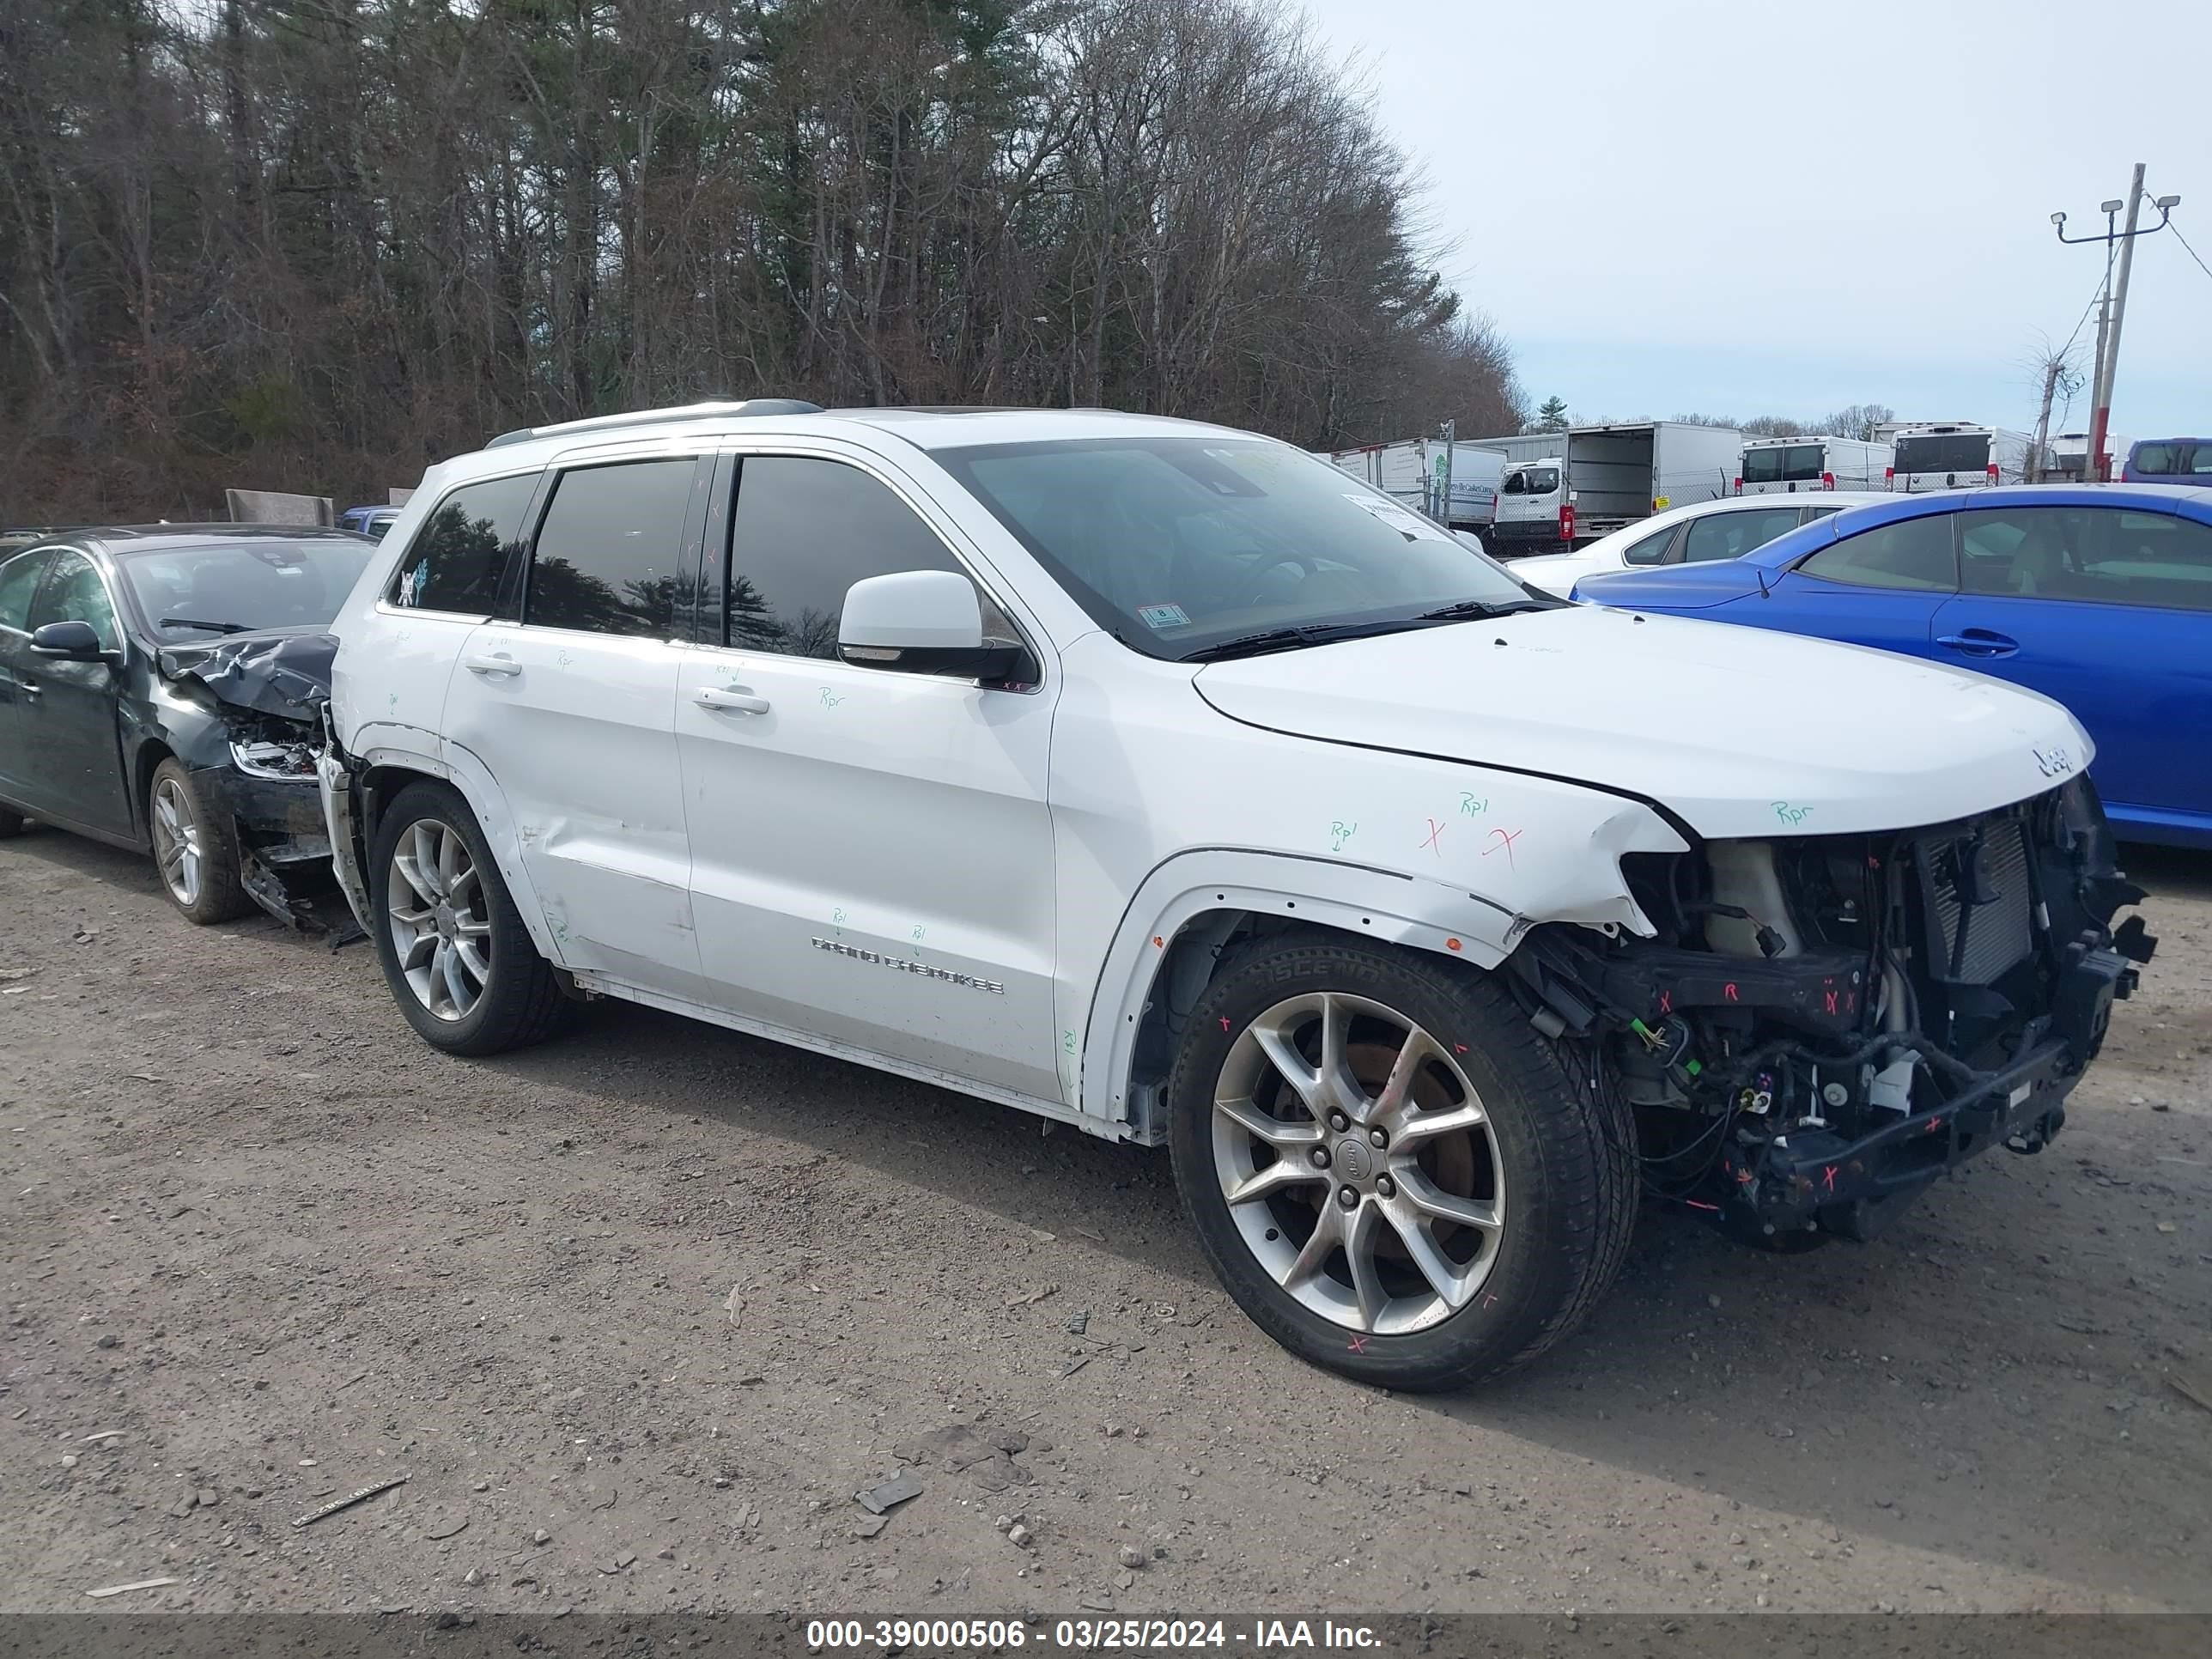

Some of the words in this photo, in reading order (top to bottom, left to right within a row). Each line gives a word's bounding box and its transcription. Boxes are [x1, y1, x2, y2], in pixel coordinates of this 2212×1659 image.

[818, 687, 846, 711] Rpr
[1771, 801, 1814, 825] Rpr
[811, 936, 880, 963] GRAND
[884, 955, 1005, 994] CHEROKEE
